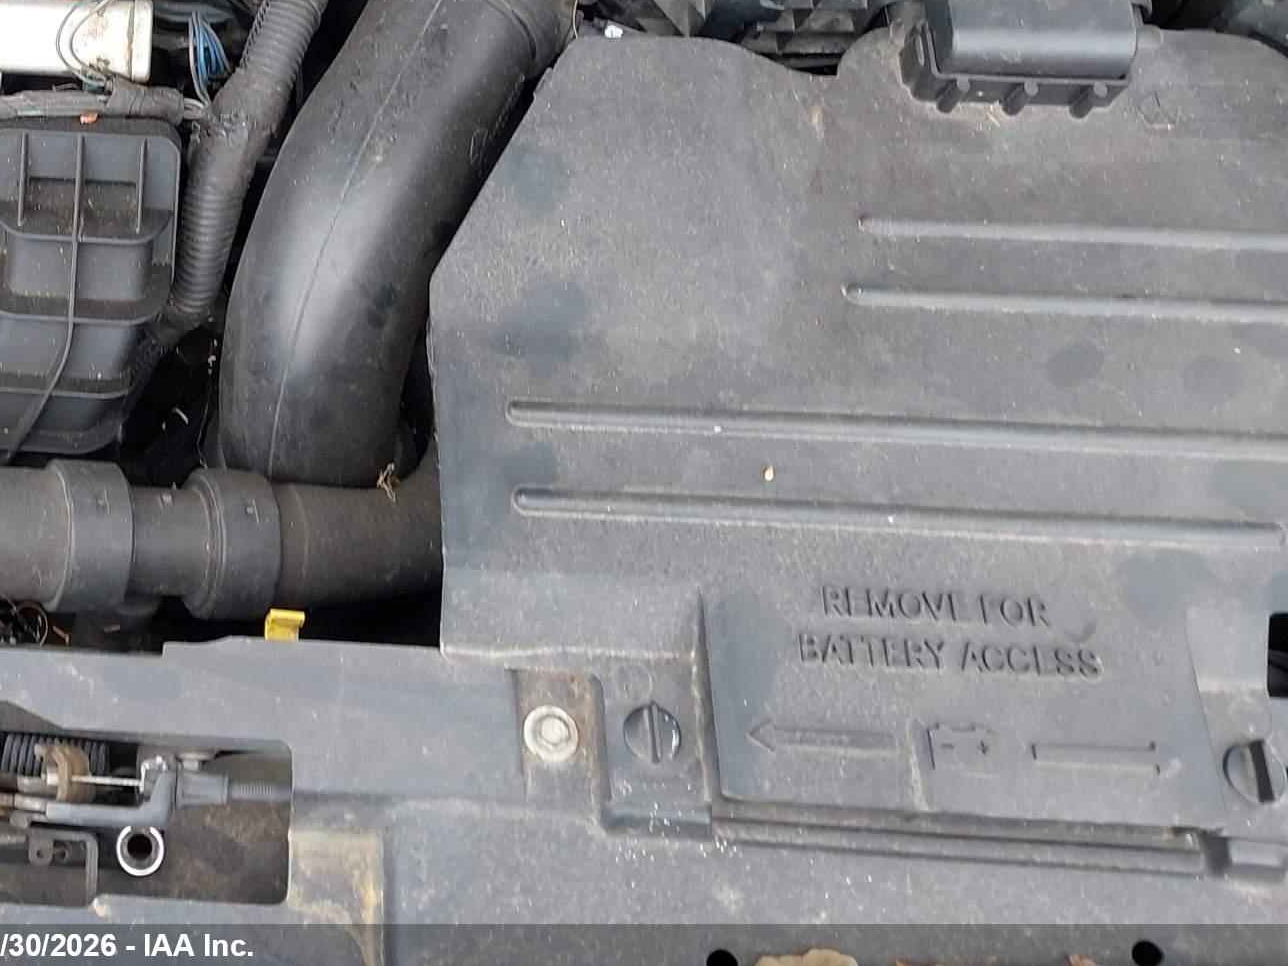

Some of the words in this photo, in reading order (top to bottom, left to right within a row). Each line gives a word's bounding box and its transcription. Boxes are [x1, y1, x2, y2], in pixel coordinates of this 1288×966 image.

[821, 585, 961, 623] REMOVE
[979, 593, 1050, 629] FOR
[798, 633, 945, 670] BATTERY
[961, 640, 1104, 678] ACCESS
